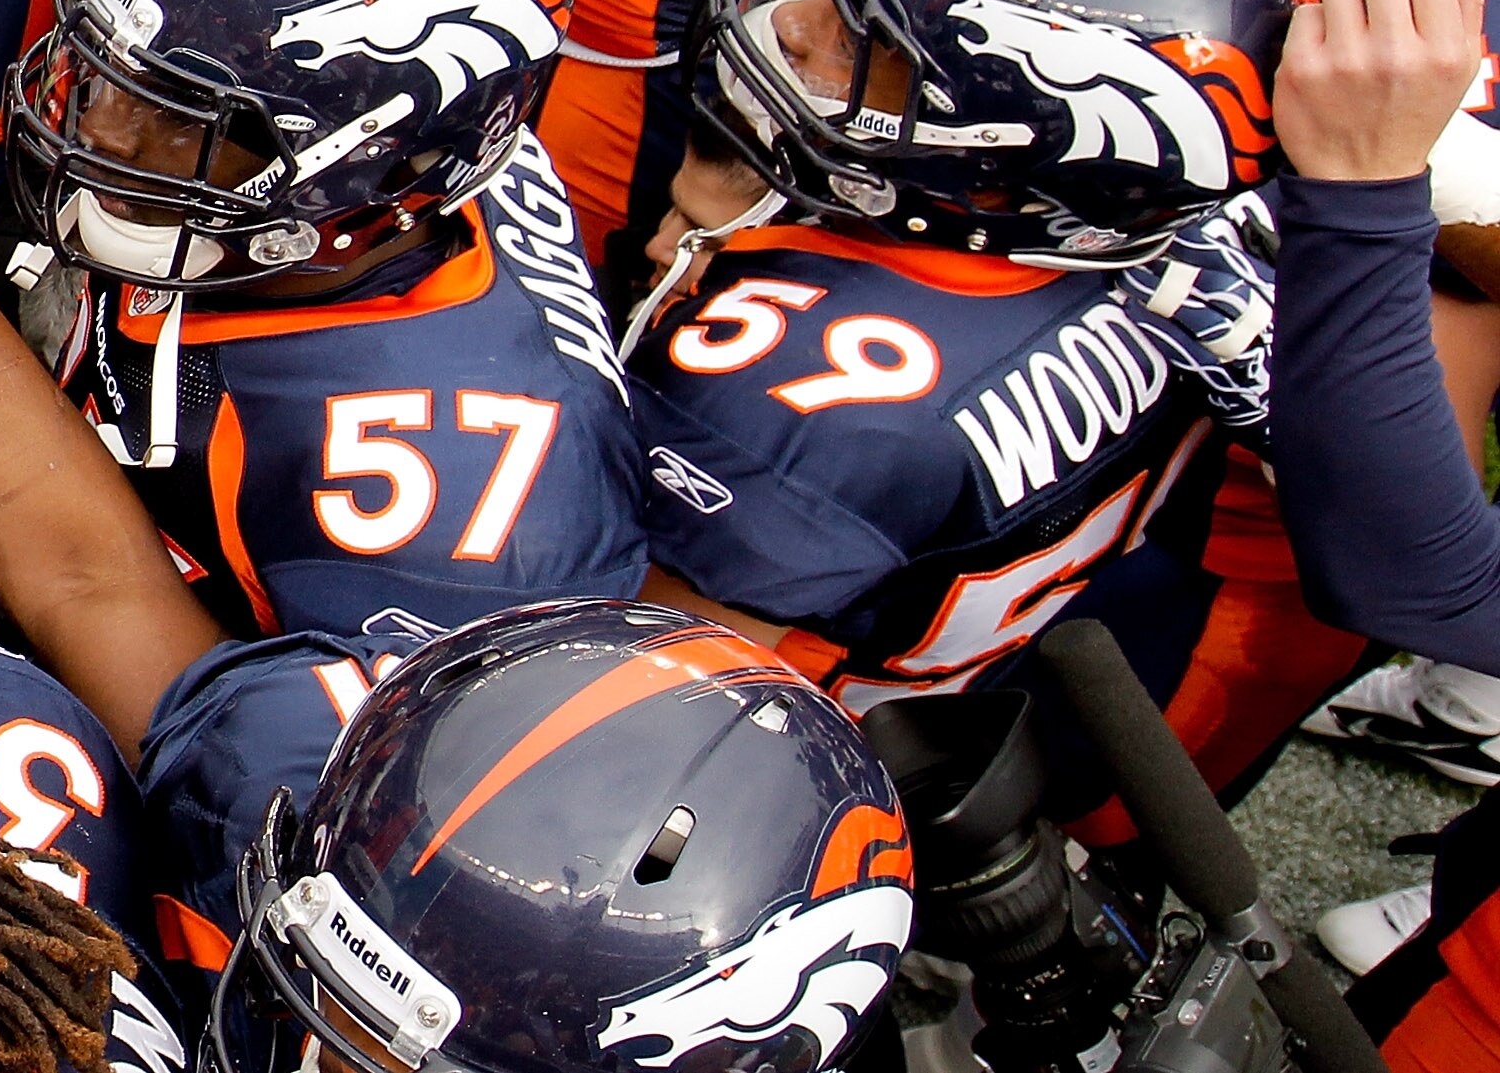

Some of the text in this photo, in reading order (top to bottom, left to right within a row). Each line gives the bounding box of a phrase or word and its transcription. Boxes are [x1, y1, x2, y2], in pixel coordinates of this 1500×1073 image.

[668, 278, 940, 414] 59
[313, 388, 561, 563] 57
[330, 911, 412, 996] Riddell
